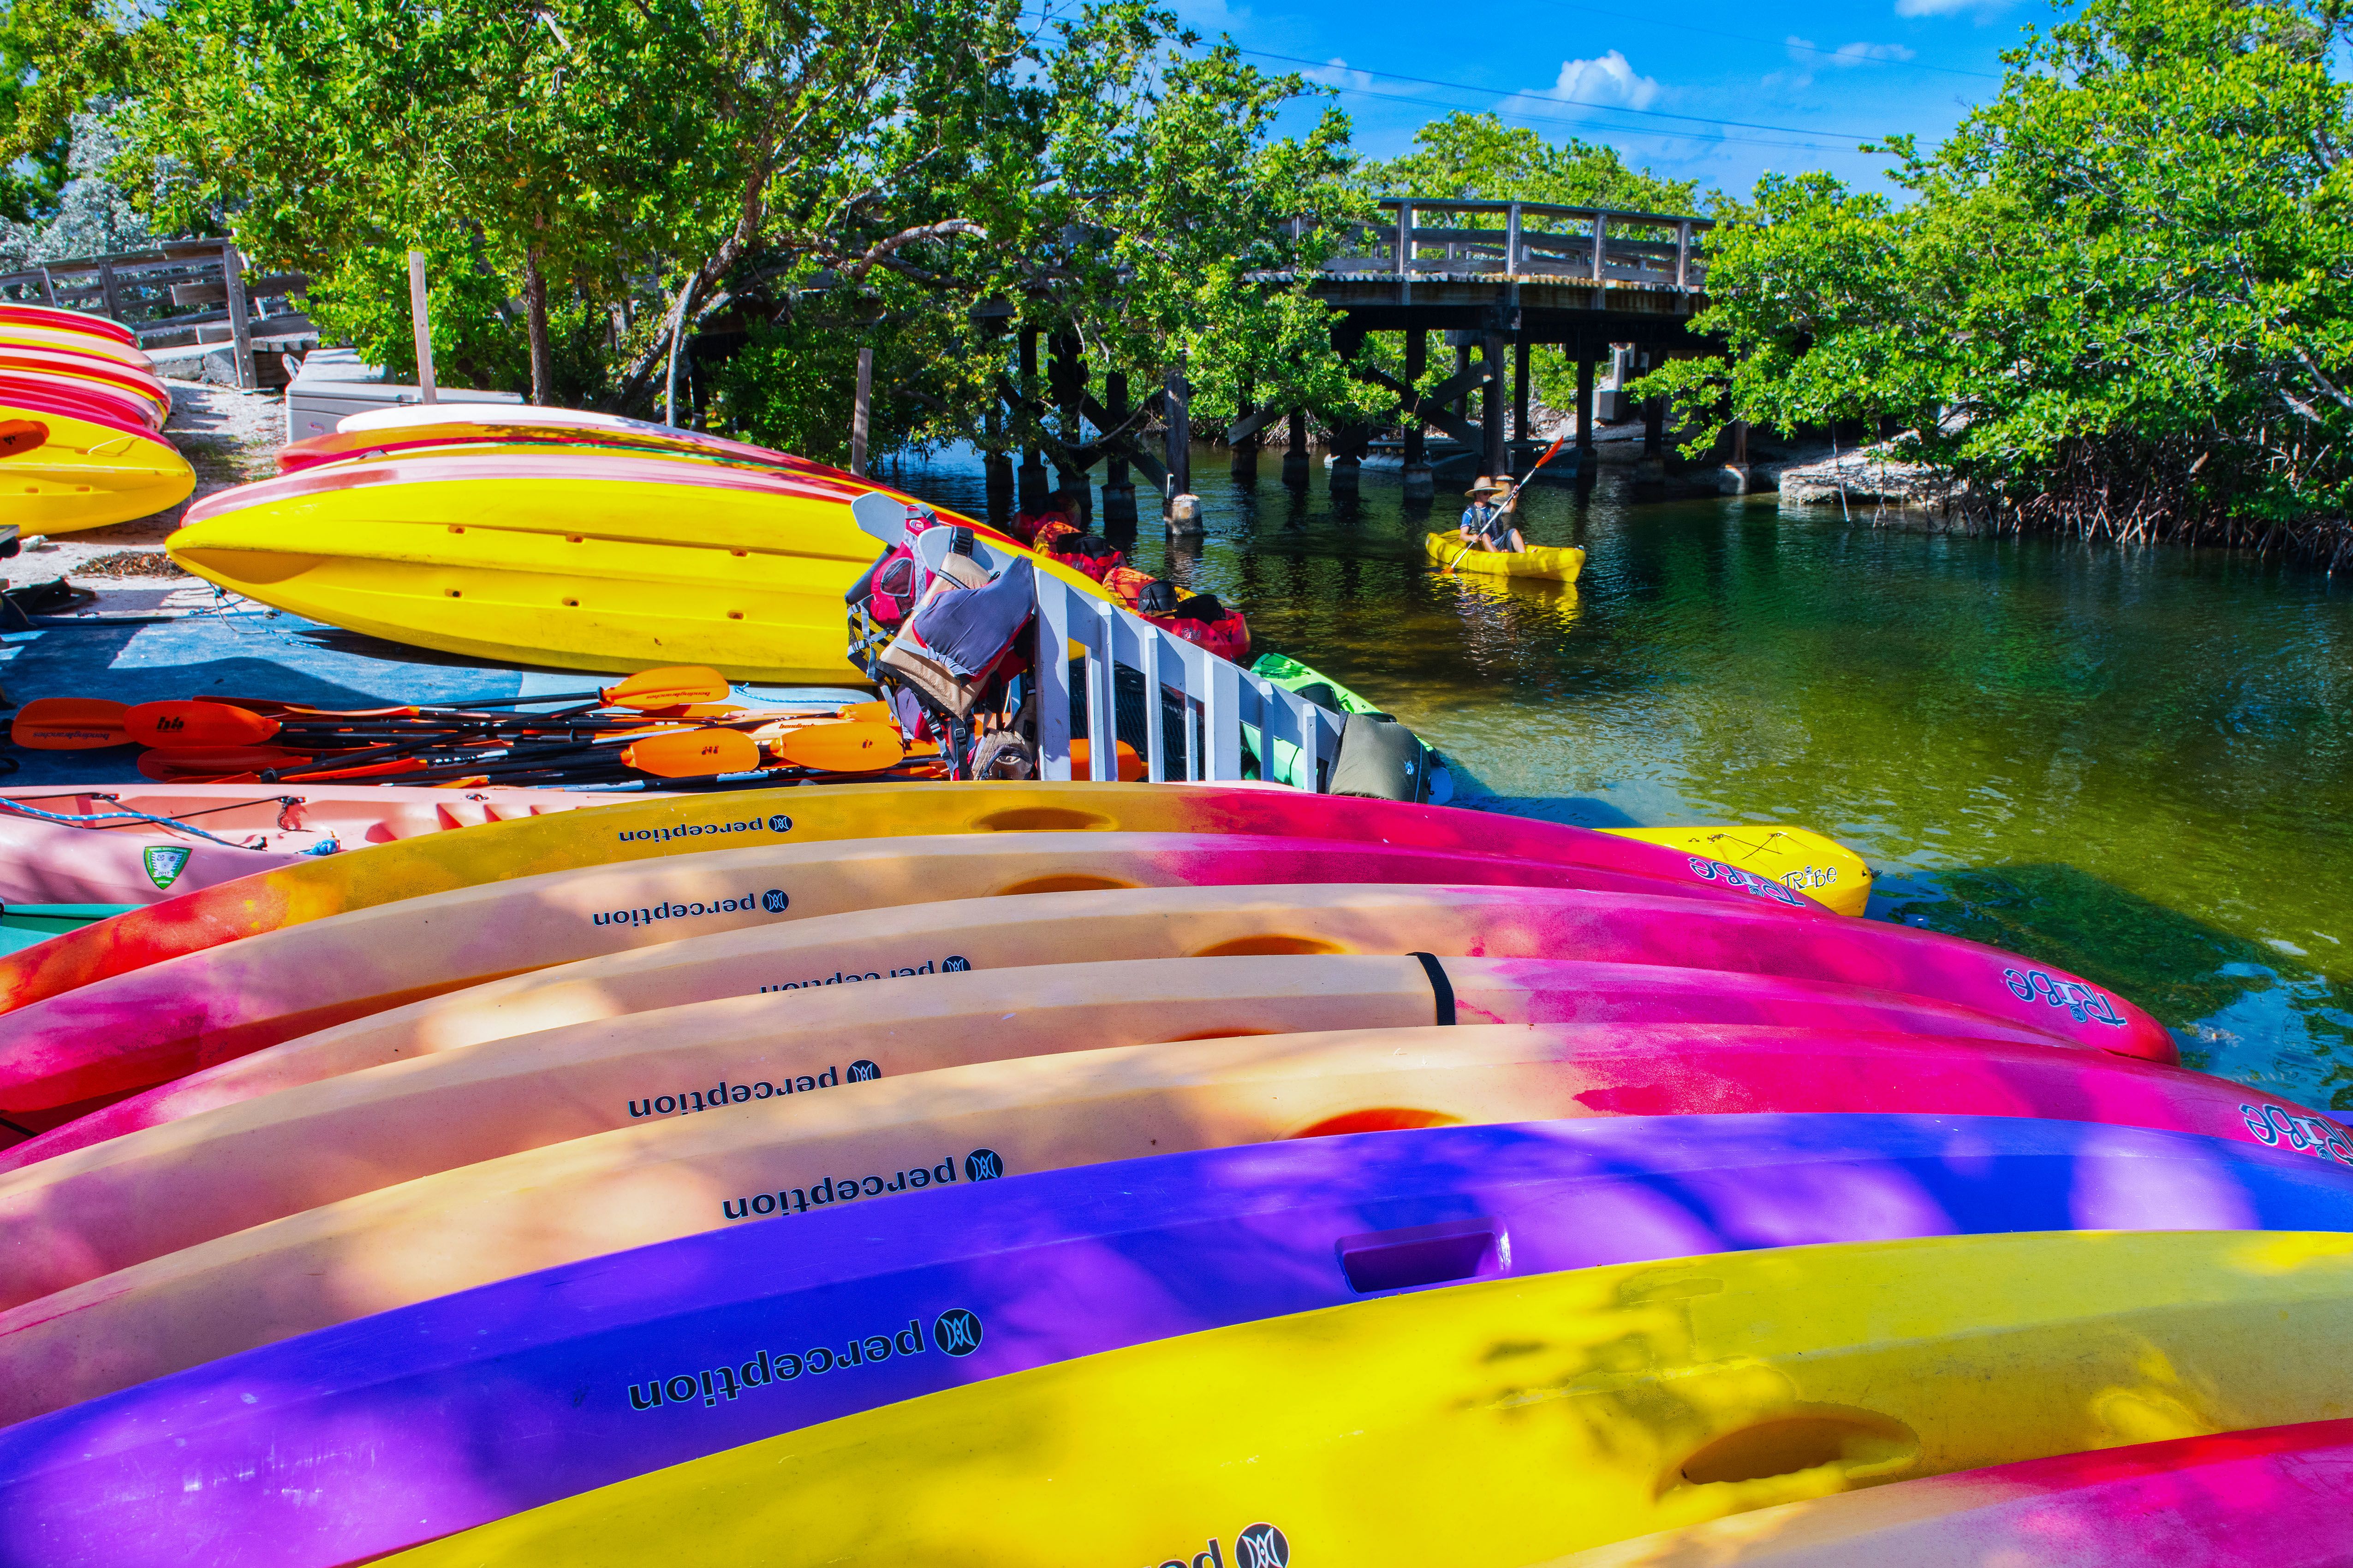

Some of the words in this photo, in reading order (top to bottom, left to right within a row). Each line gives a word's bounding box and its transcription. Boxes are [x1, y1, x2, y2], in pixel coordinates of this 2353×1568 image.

[619, 817, 764, 843] perception
[593, 893, 757, 927] perception
[628, 1066, 839, 1118] perception
[722, 1156, 958, 1220] perception
[628, 1319, 925, 1411] perception
